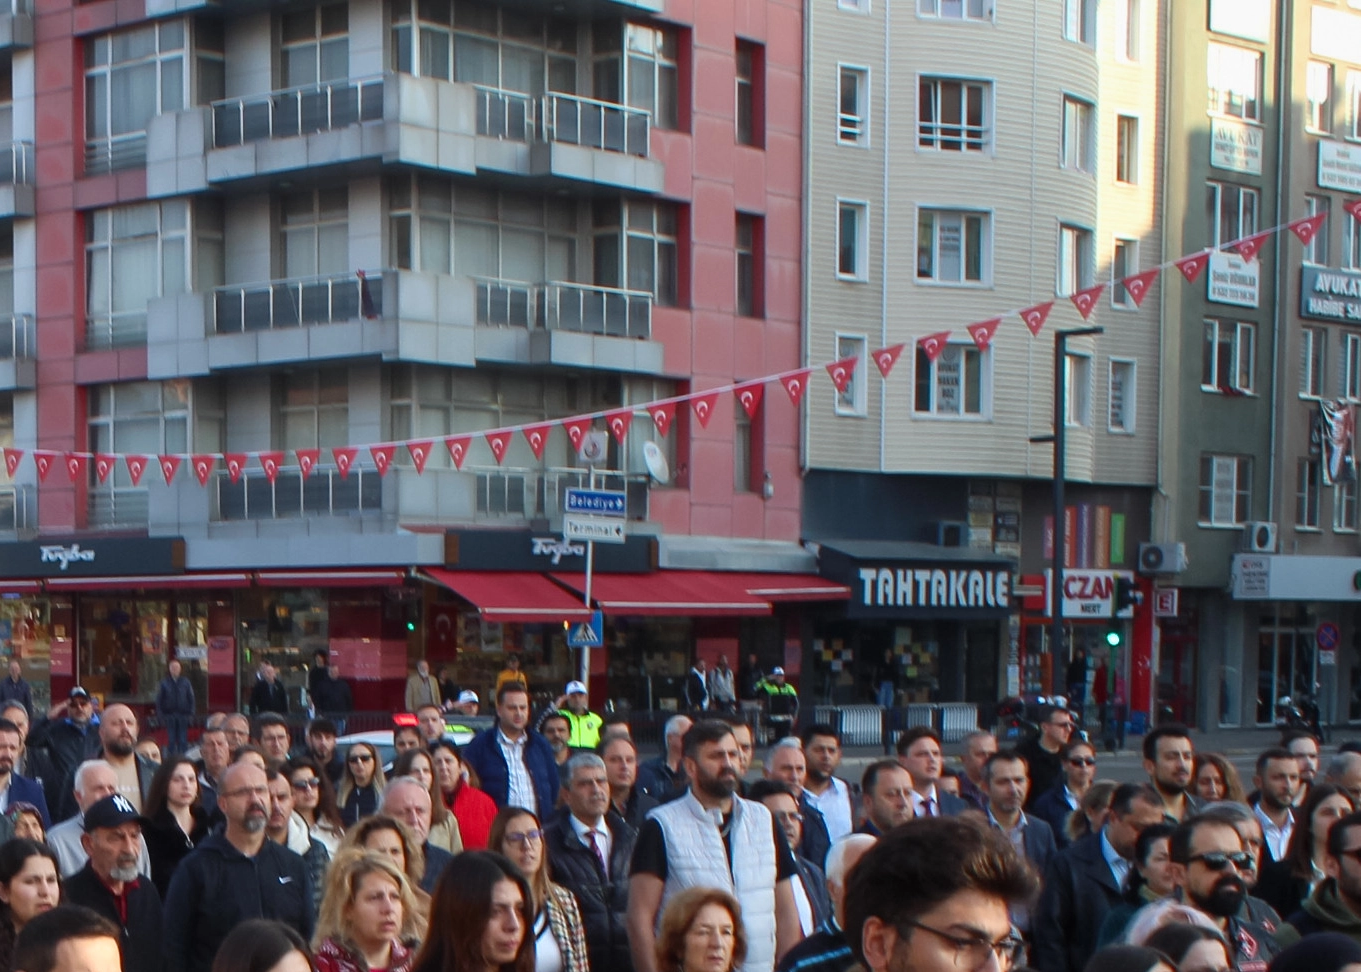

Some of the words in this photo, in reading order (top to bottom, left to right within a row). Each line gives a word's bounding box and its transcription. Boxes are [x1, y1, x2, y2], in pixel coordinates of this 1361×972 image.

[569, 494, 615, 512] Belediye
[568, 520, 613, 535] Terminal
[859, 568, 1009, 606] TAHTAKALE
